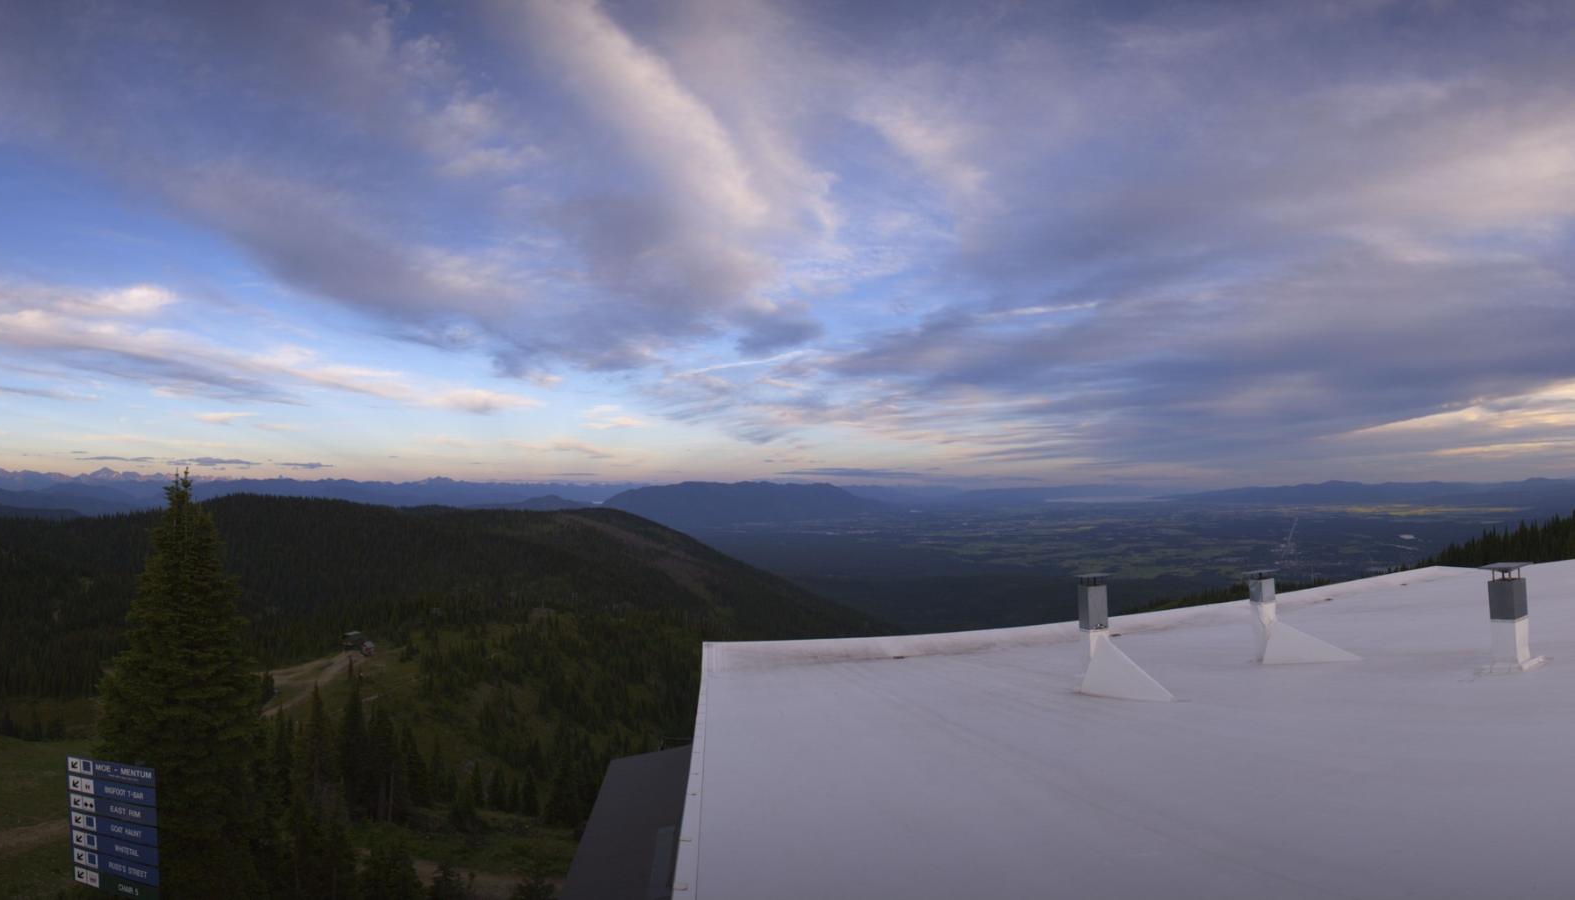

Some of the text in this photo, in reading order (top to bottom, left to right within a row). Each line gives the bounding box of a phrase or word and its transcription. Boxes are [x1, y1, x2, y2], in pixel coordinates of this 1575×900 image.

[95, 763, 111, 772] MOE
[120, 767, 152, 780] MENTUM
[110, 805, 126, 816] EAST
